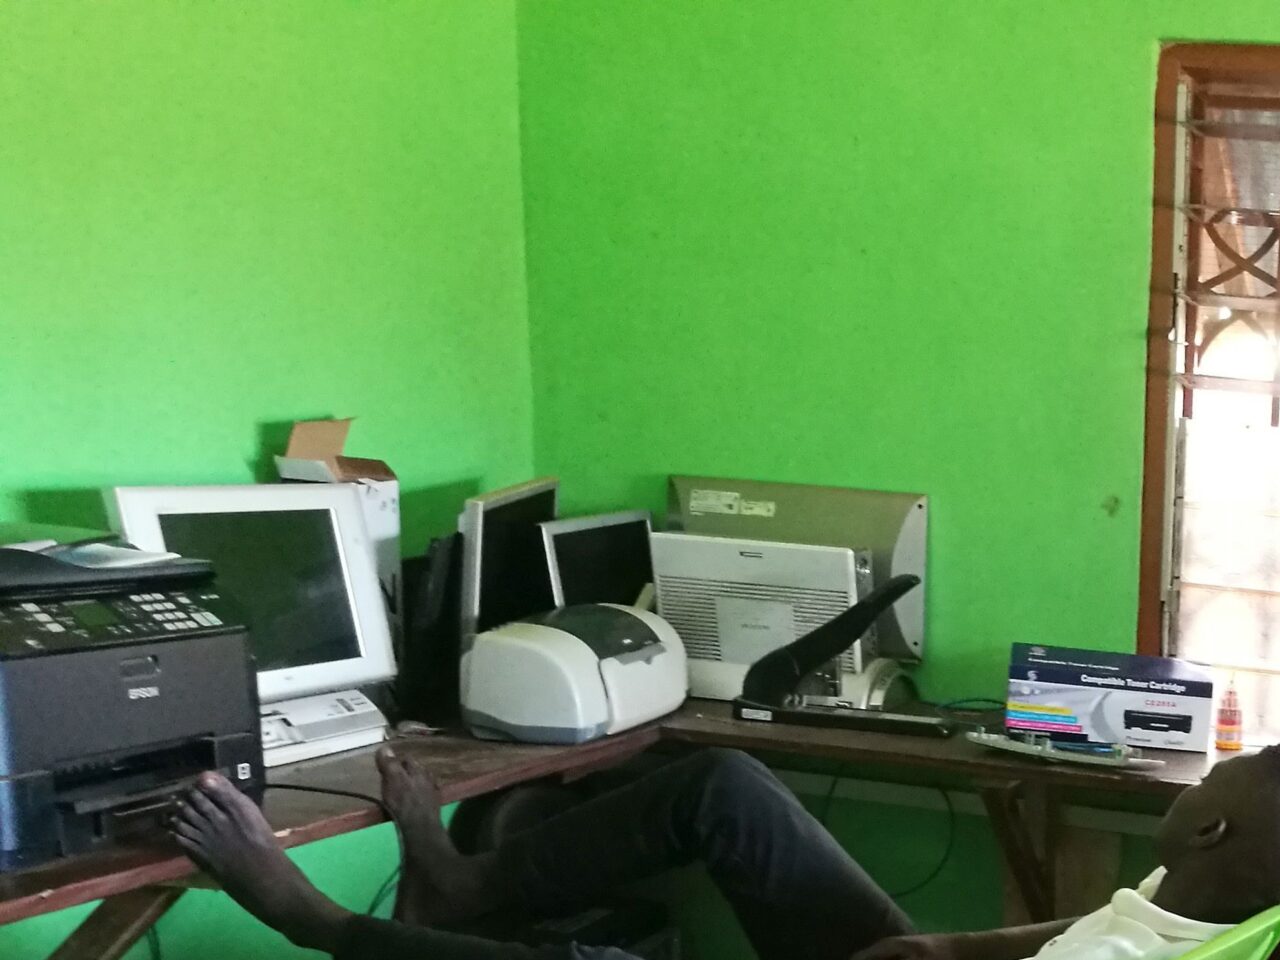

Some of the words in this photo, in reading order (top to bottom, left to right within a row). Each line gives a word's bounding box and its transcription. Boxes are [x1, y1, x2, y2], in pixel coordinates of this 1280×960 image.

[1080, 674, 1125, 687] Compatible
[1125, 679, 1149, 689] Toner
[1149, 681, 1187, 694] Cartridge
[128, 686, 160, 700] EPSON
